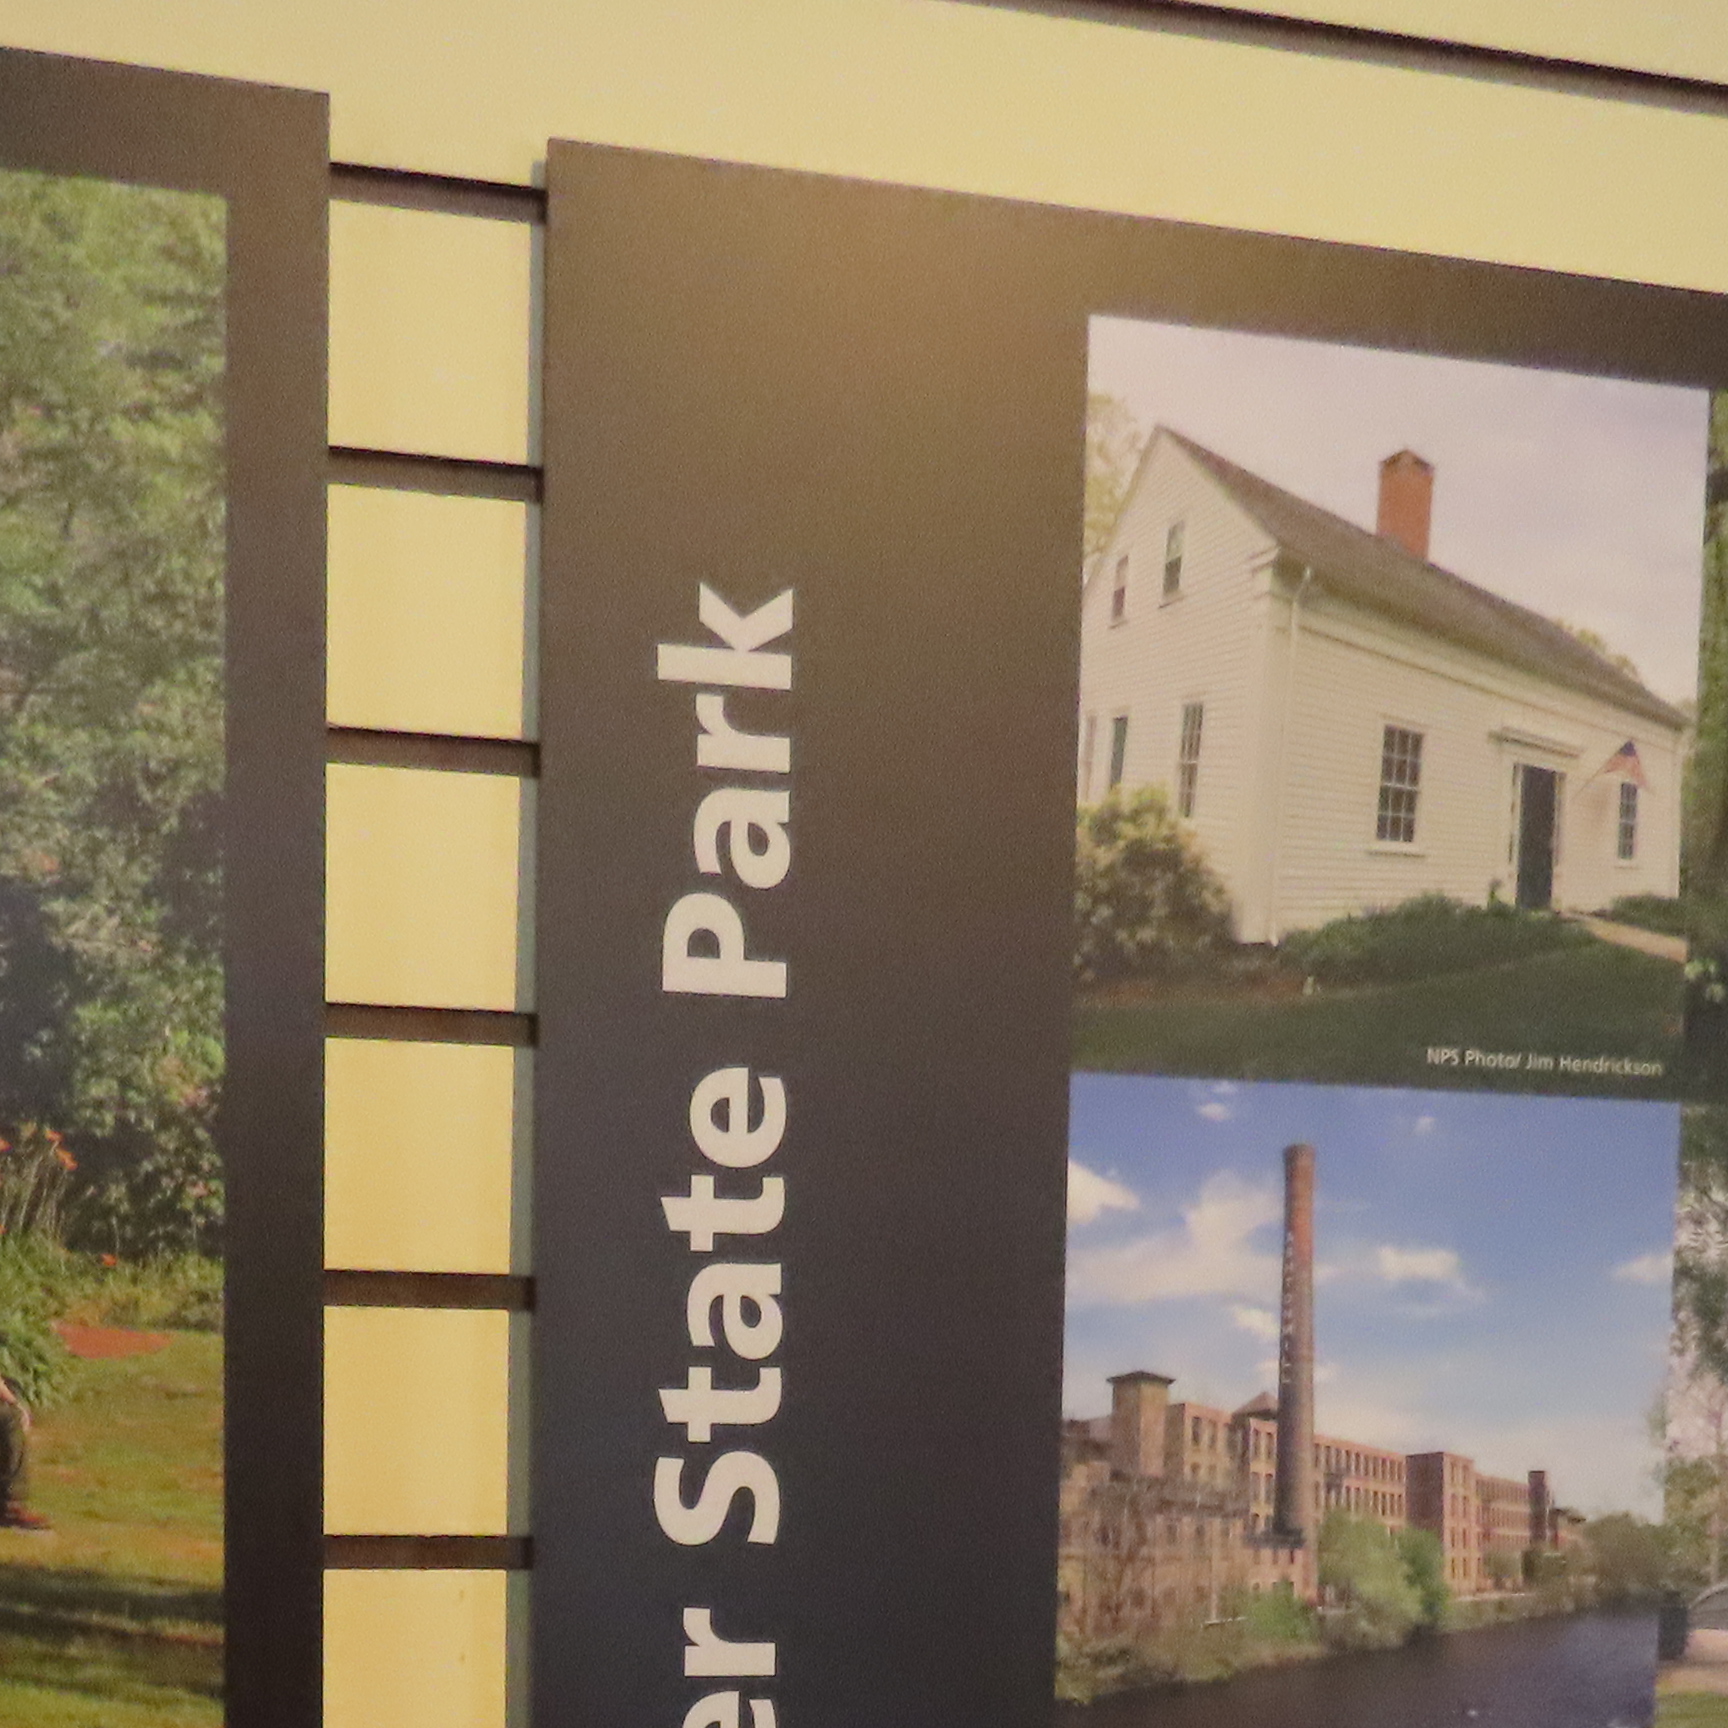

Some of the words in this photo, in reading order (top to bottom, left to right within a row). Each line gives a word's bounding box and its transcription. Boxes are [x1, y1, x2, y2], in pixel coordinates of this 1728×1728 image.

[656, 581, 795, 998] Park
[1426, 1048, 1459, 1065] NPS
[1464, 1049, 1520, 1069] Photo/
[1526, 1053, 1553, 1070] Jim
[1559, 1055, 1663, 1077] Hendrickson
[654, 1067, 786, 1545] State
